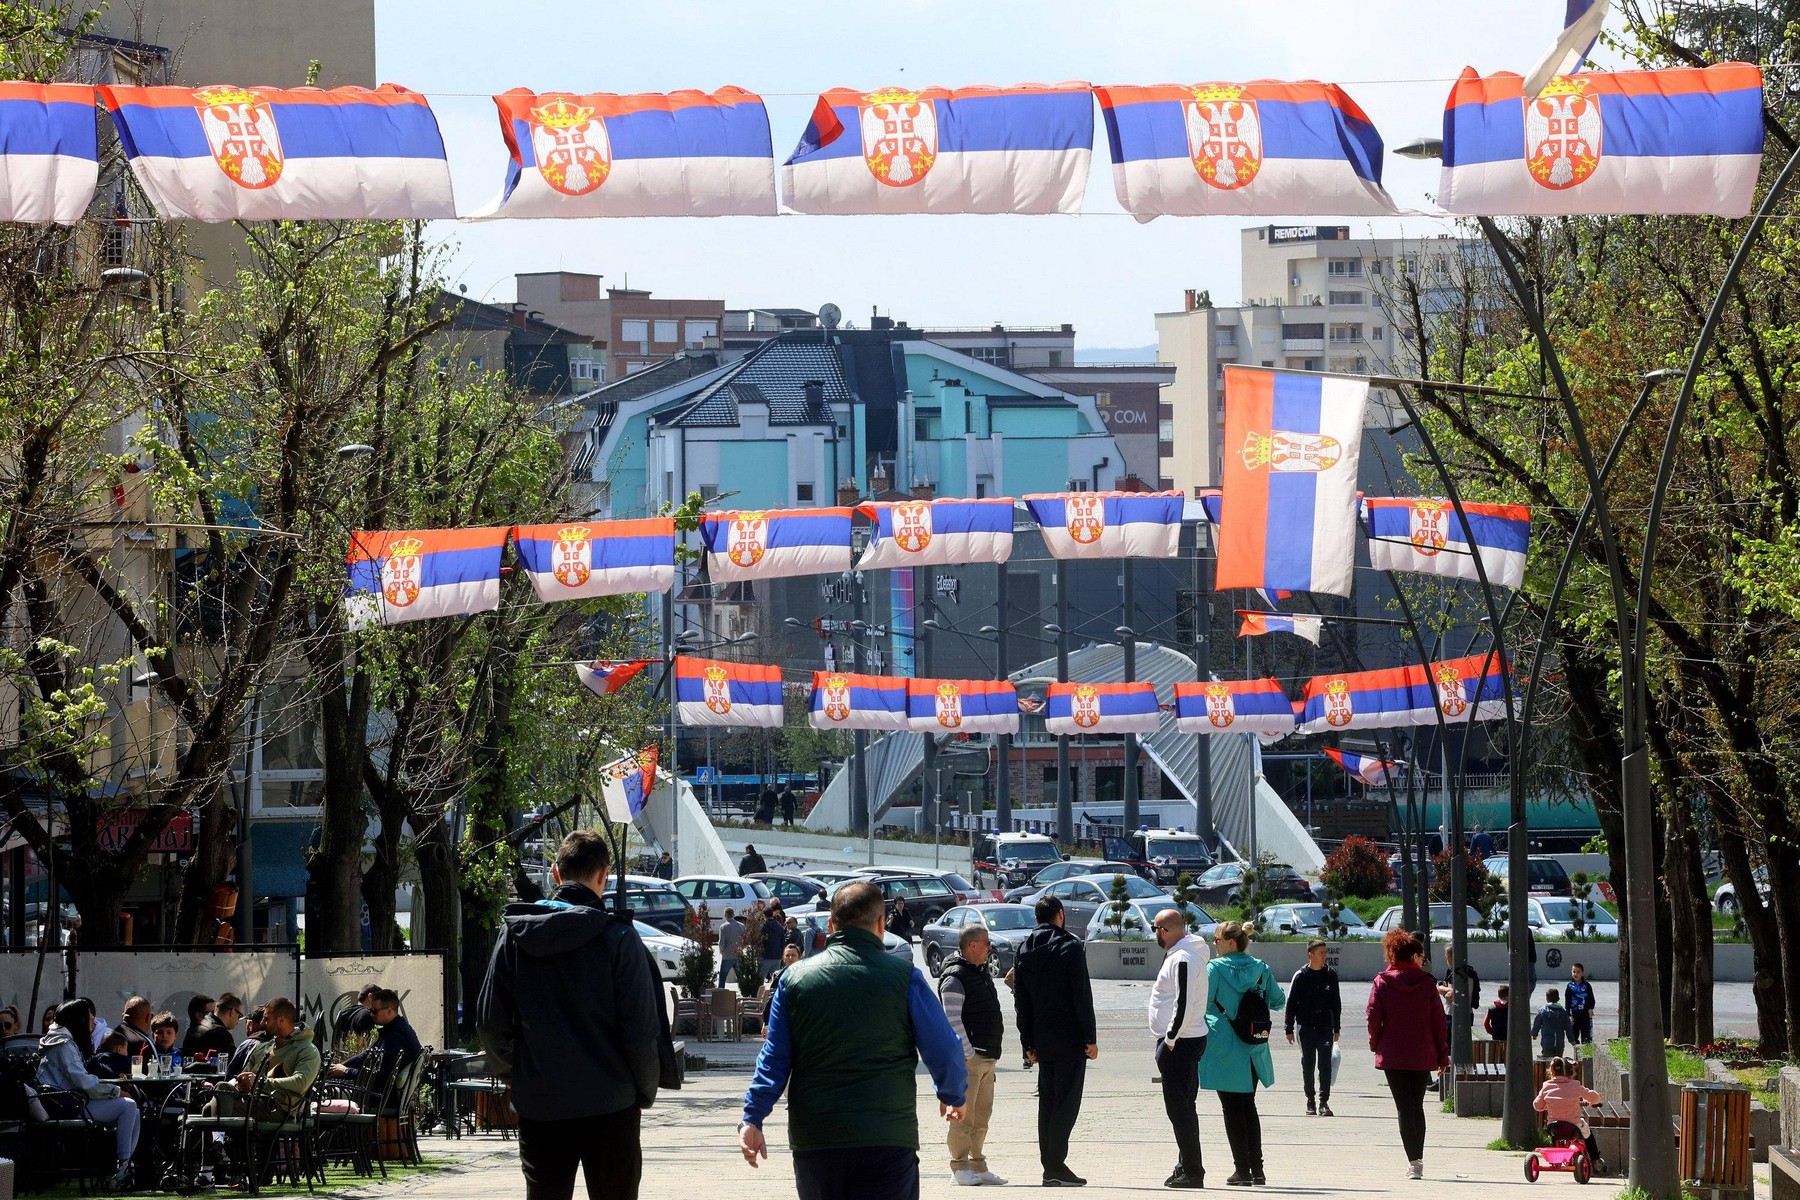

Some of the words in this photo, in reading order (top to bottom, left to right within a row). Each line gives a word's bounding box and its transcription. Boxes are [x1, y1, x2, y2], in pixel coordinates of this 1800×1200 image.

[1274, 227, 1298, 239] REMO
[1298, 226, 1316, 237] COM
[1114, 410, 1147, 424] COM
